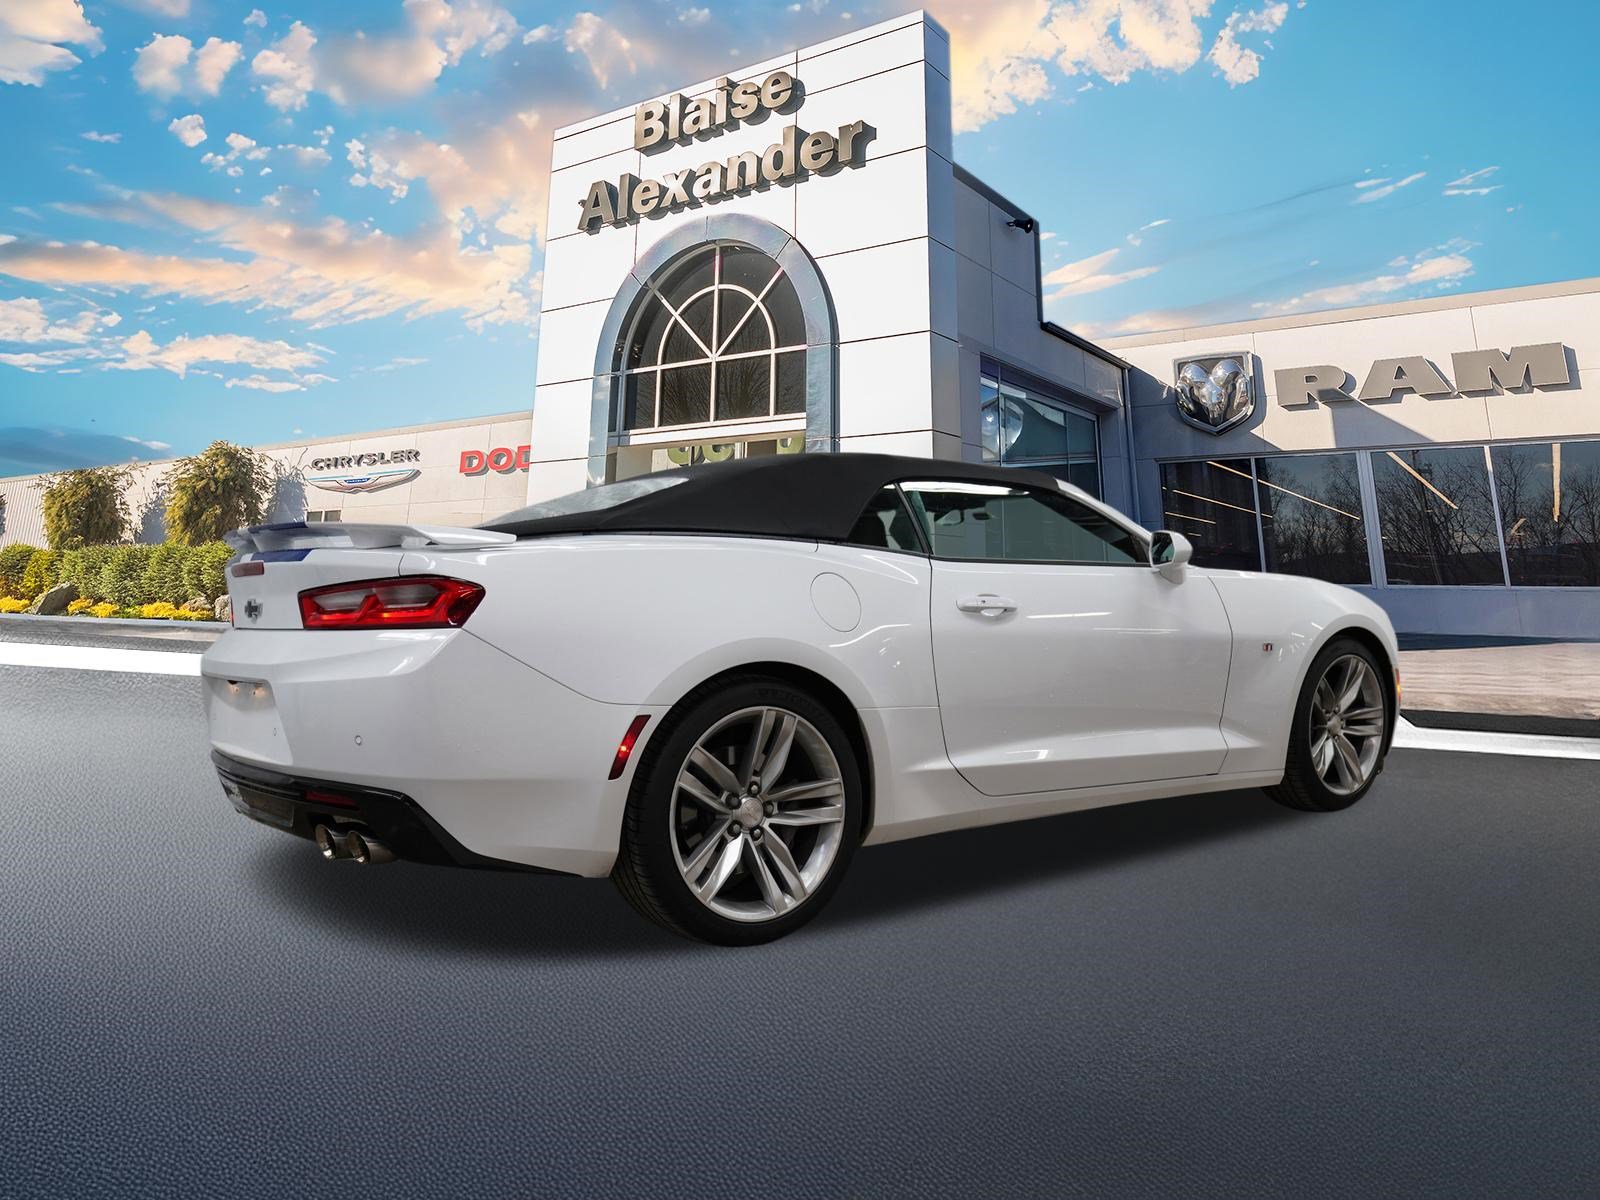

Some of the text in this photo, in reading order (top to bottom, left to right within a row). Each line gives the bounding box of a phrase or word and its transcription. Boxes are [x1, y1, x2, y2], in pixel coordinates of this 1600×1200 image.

[634, 71, 804, 156] Blaise
[577, 119, 876, 234] Alexander
[1274, 342, 1571, 407] RAM
[311, 448, 420, 471] CHRYSLER
